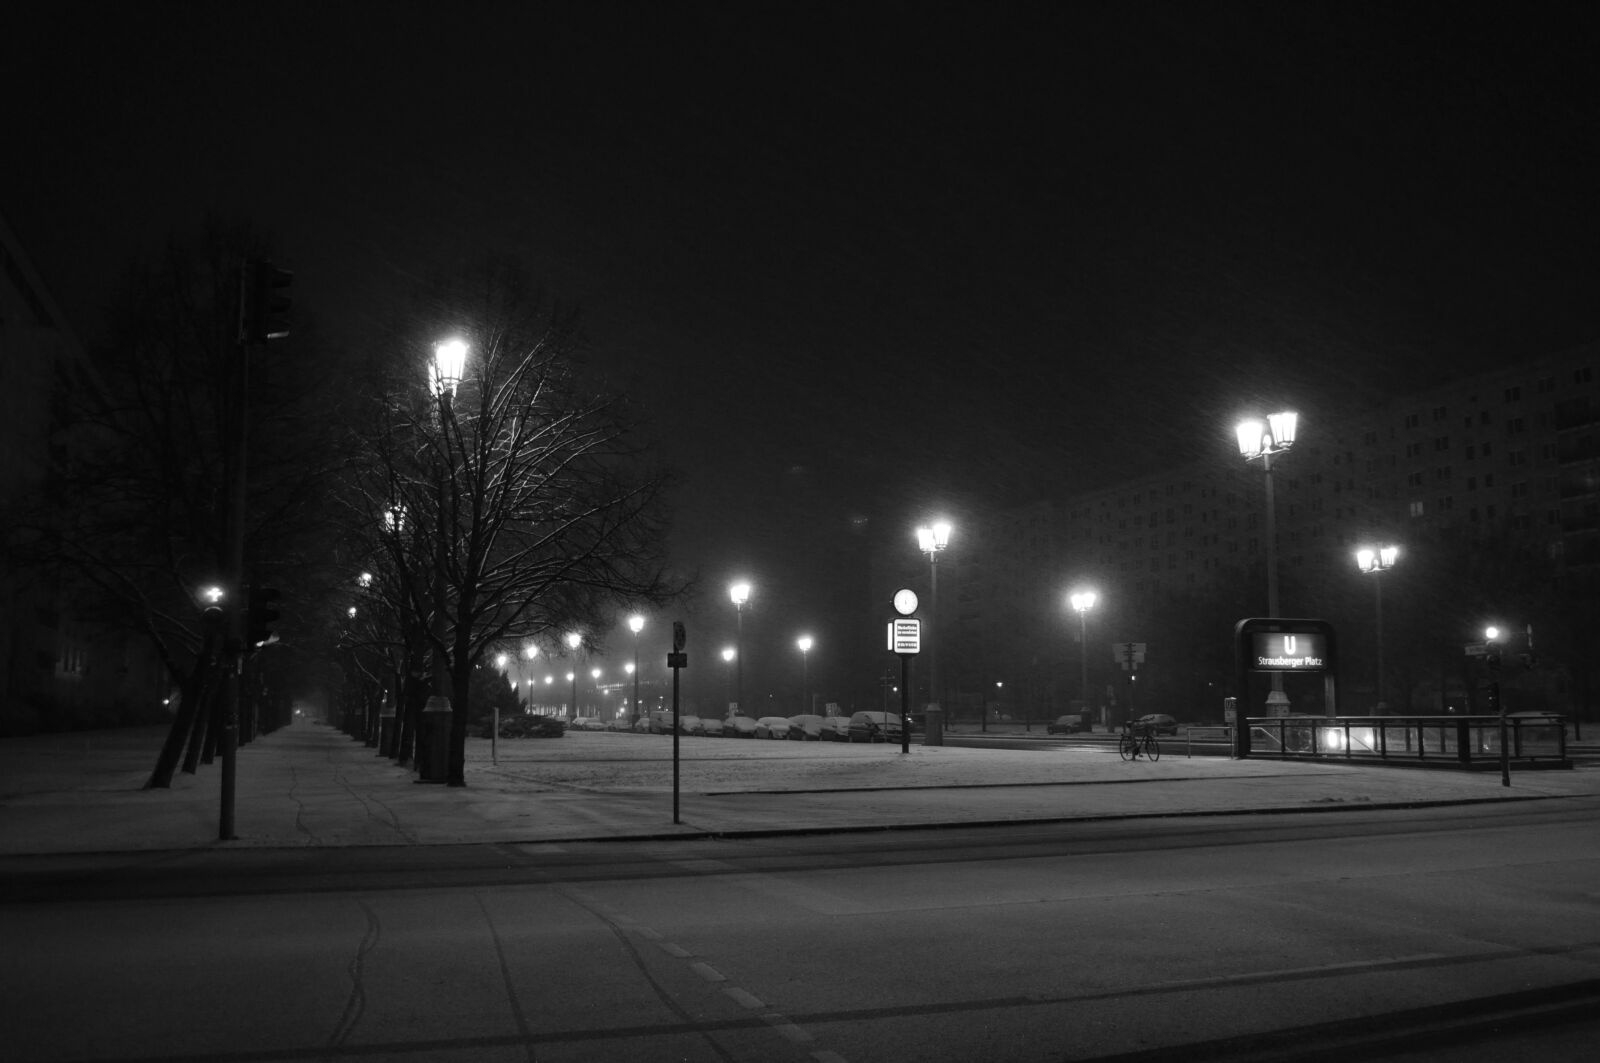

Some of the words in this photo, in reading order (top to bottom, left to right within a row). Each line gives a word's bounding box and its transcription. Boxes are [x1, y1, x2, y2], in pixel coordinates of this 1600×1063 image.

[1284, 636, 1296, 655] U
[1258, 656, 1304, 668] Strausberger
[1304, 656, 1323, 666] Platz
